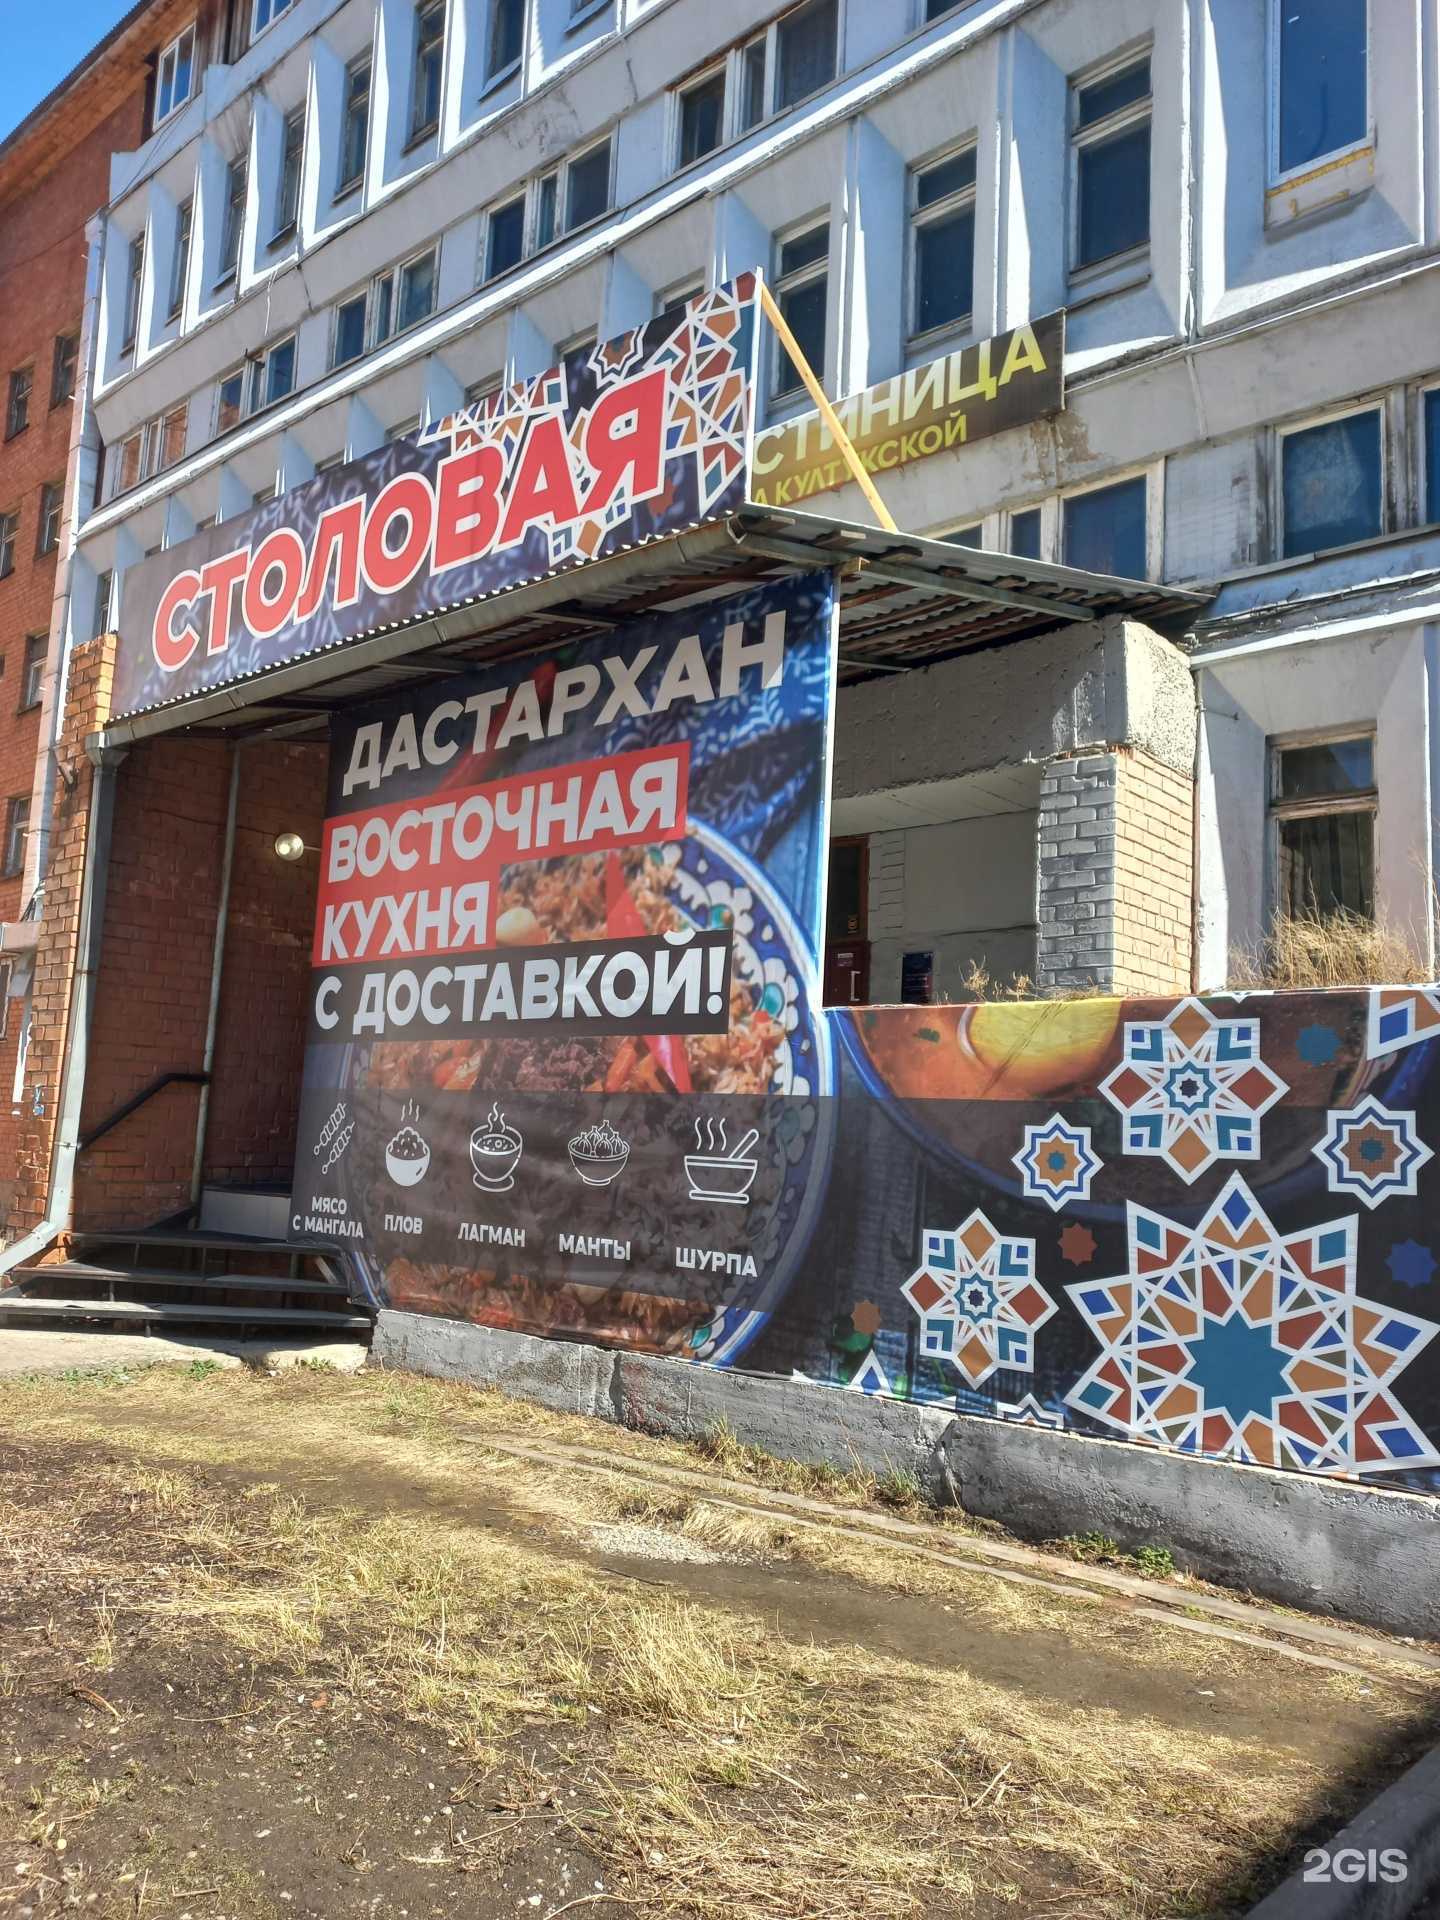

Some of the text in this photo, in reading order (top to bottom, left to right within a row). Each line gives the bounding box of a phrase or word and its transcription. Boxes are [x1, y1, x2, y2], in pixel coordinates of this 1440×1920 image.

[152, 363, 671, 672] СТОЛОВАЯ
[342, 610, 786, 796] ДАСТАРХАН
[328, 757, 679, 883] ВОСТОЧНАЯ
[320, 881, 490, 961] КУХНЯ
[315, 929, 727, 1035] С ДОСТАВКОЙ!
[311, 1195, 348, 1215] МЯСО
[292, 1215, 364, 1239] С МАНГАЛА
[384, 1214, 423, 1235] ПЛОВ
[458, 1222, 526, 1248] ЛАГМАН
[559, 1233, 631, 1261] МАНТЫ
[675, 1246, 758, 1278] ШУРПА
